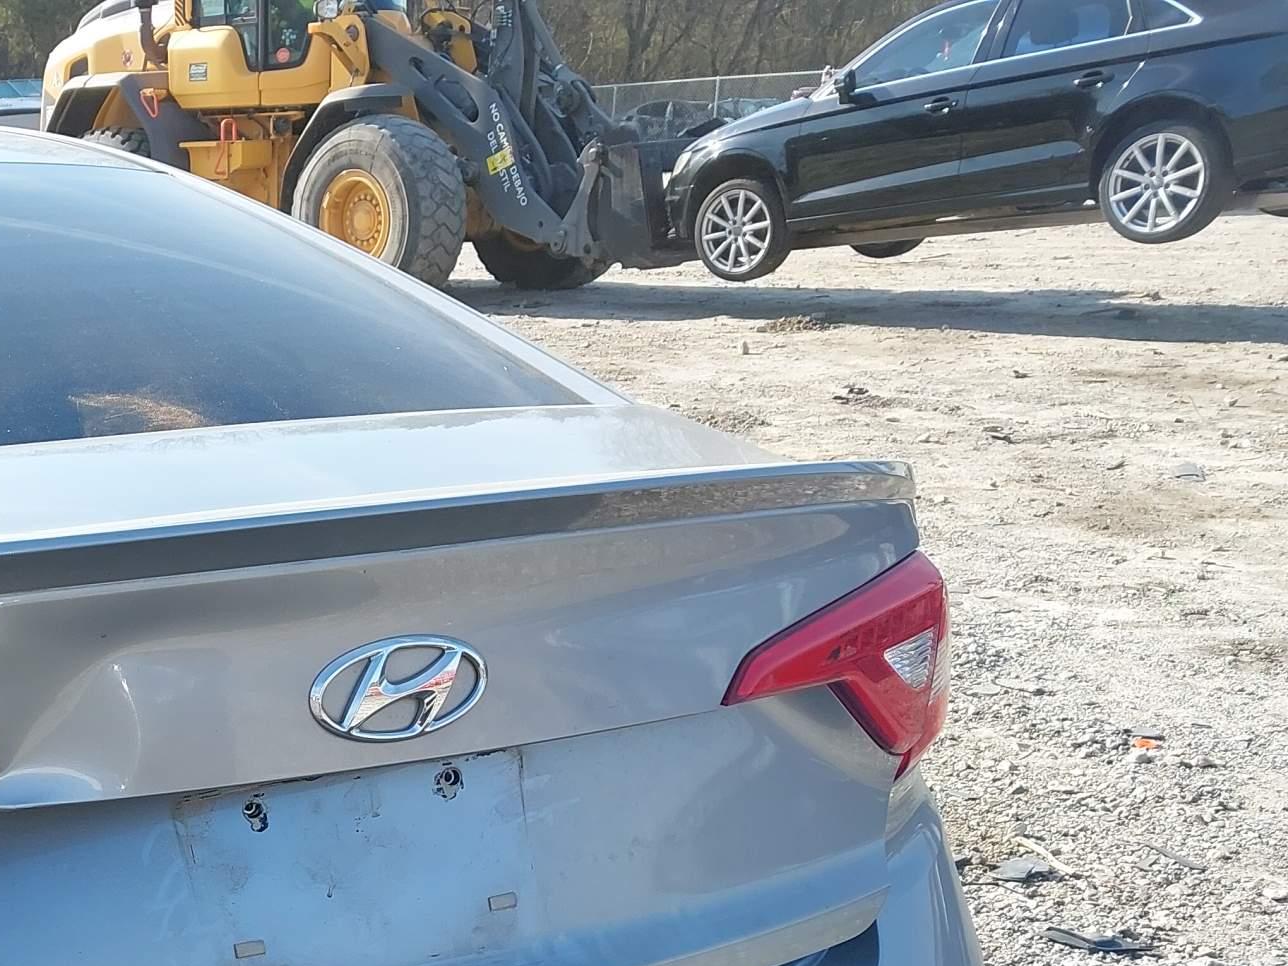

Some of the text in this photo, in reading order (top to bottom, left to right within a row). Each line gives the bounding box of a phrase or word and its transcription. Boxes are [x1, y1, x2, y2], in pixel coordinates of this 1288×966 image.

[487, 131, 511, 192] DEL STIL
[489, 103, 500, 122] NO
[510, 166, 528, 206] DEBAJO
